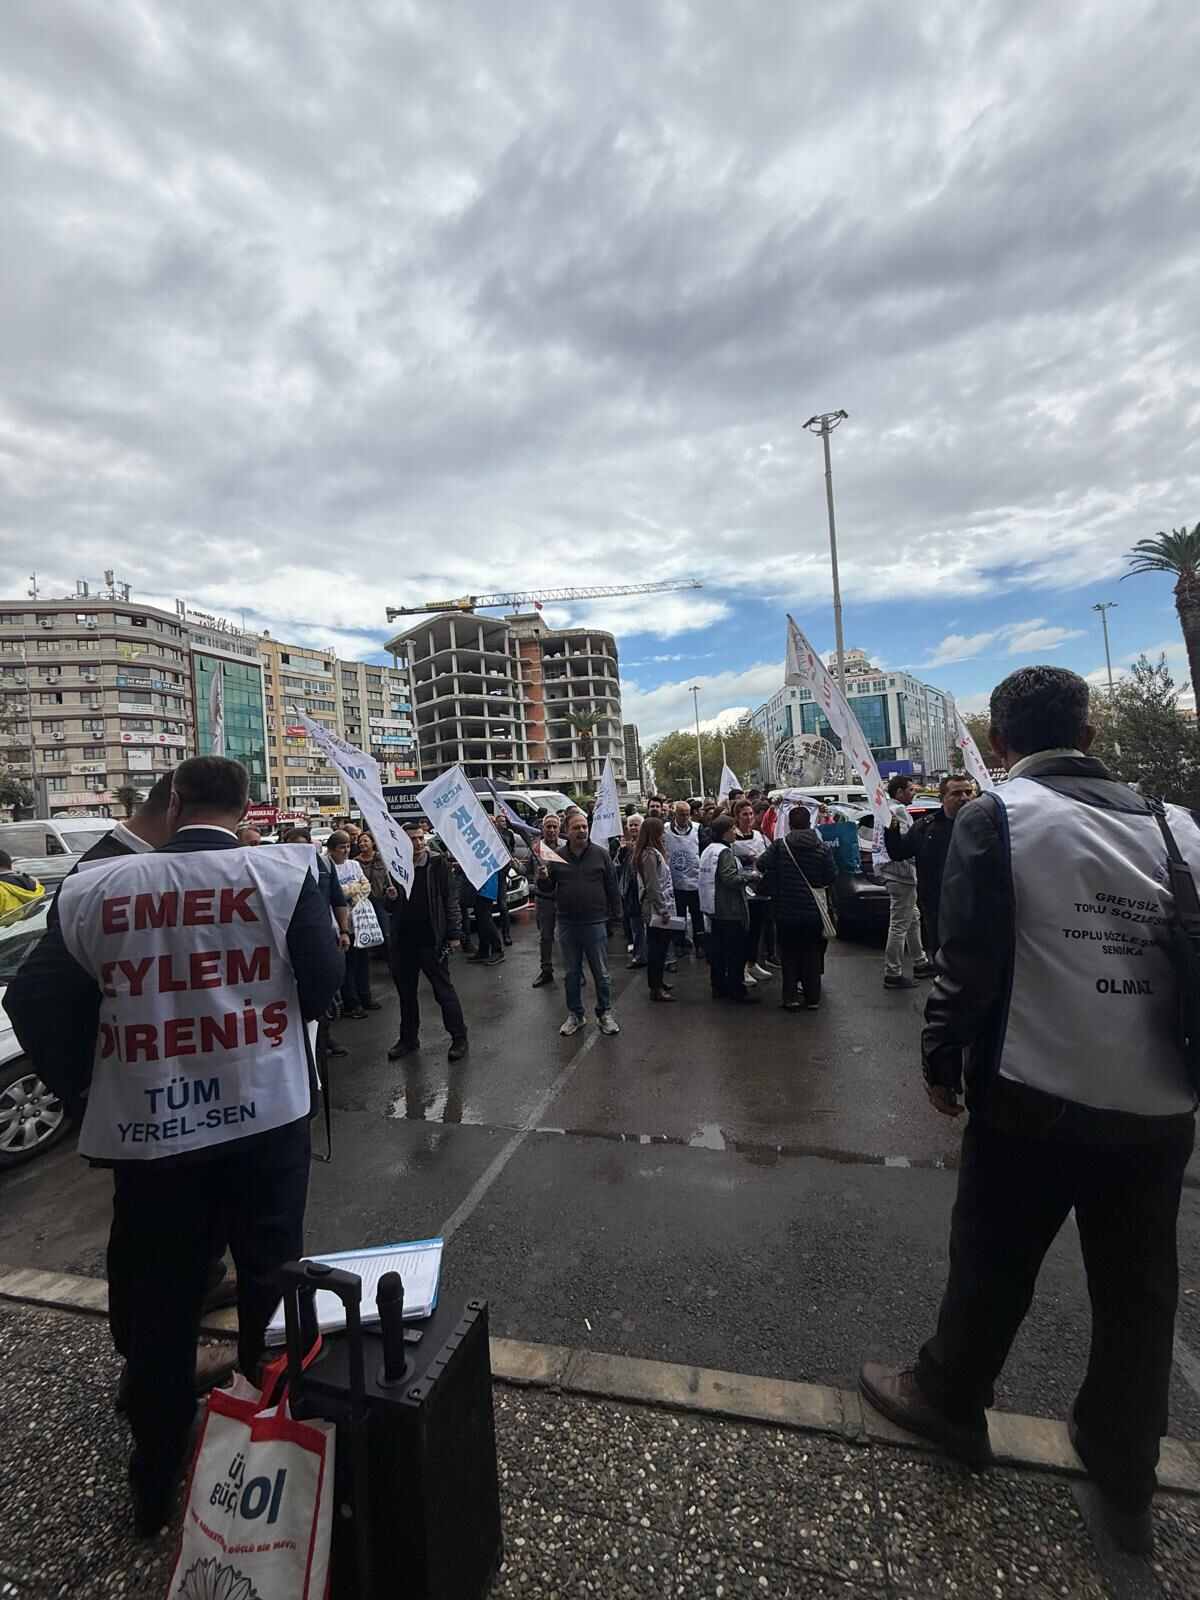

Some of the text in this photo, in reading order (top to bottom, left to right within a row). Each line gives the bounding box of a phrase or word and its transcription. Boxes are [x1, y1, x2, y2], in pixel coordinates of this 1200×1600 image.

[102, 887, 259, 934] EMEK
[1062, 928, 1103, 941] TOPLU
[144, 1077, 221, 1115] TÜM
[116, 1101, 257, 1143] YEREL-SEN
